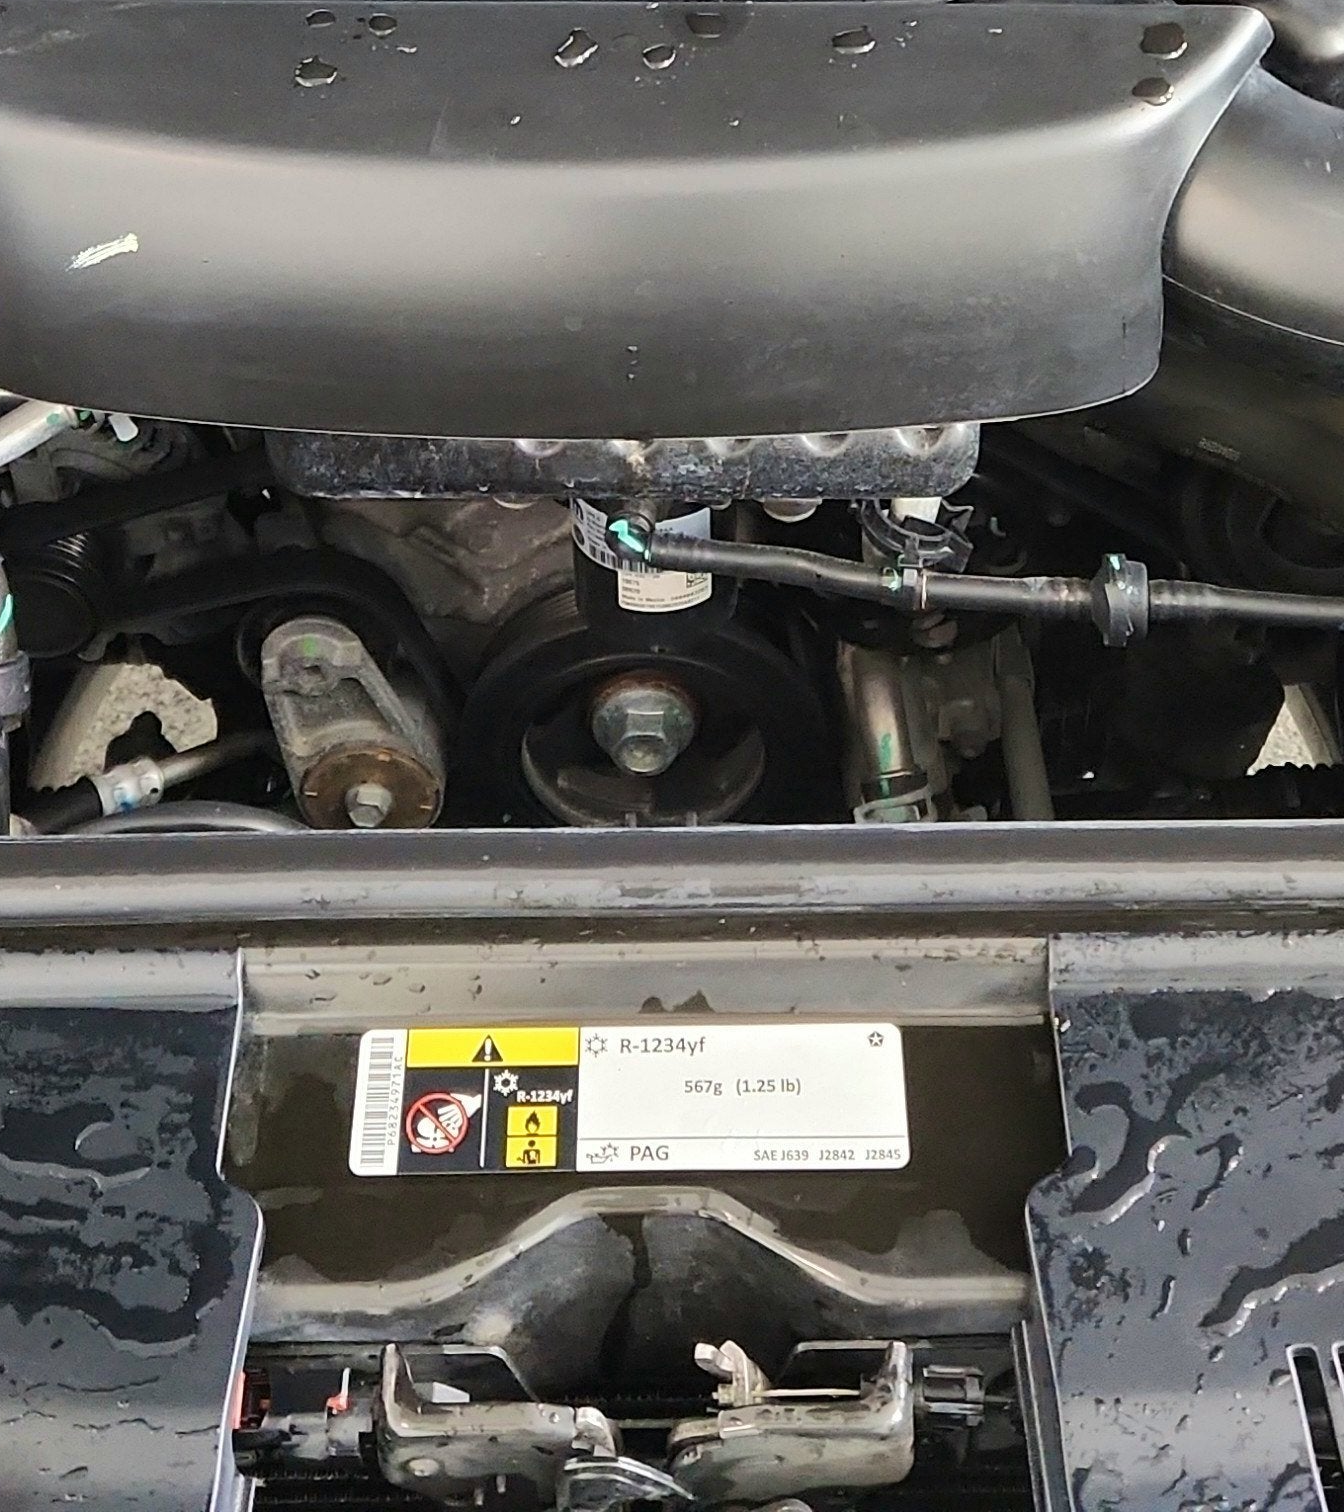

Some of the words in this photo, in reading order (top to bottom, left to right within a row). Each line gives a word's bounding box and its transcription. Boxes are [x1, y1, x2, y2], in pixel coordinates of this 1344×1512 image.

[620, 1036, 706, 1057] R-1234yf
[684, 1080, 723, 1096] 567g
[736, 1078, 776, 1096] (1.25
[780, 1078, 802, 1096] lb)
[387, 1056, 403, 1146] P68234971AC
[516, 1089, 574, 1105] R-1234yf
[630, 1145, 670, 1162] PAG
[754, 1149, 778, 1161] SAE
[780, 1149, 809, 1161] J639
[819, 1148, 856, 1161] J2842
[865, 1148, 902, 1161] J2845
